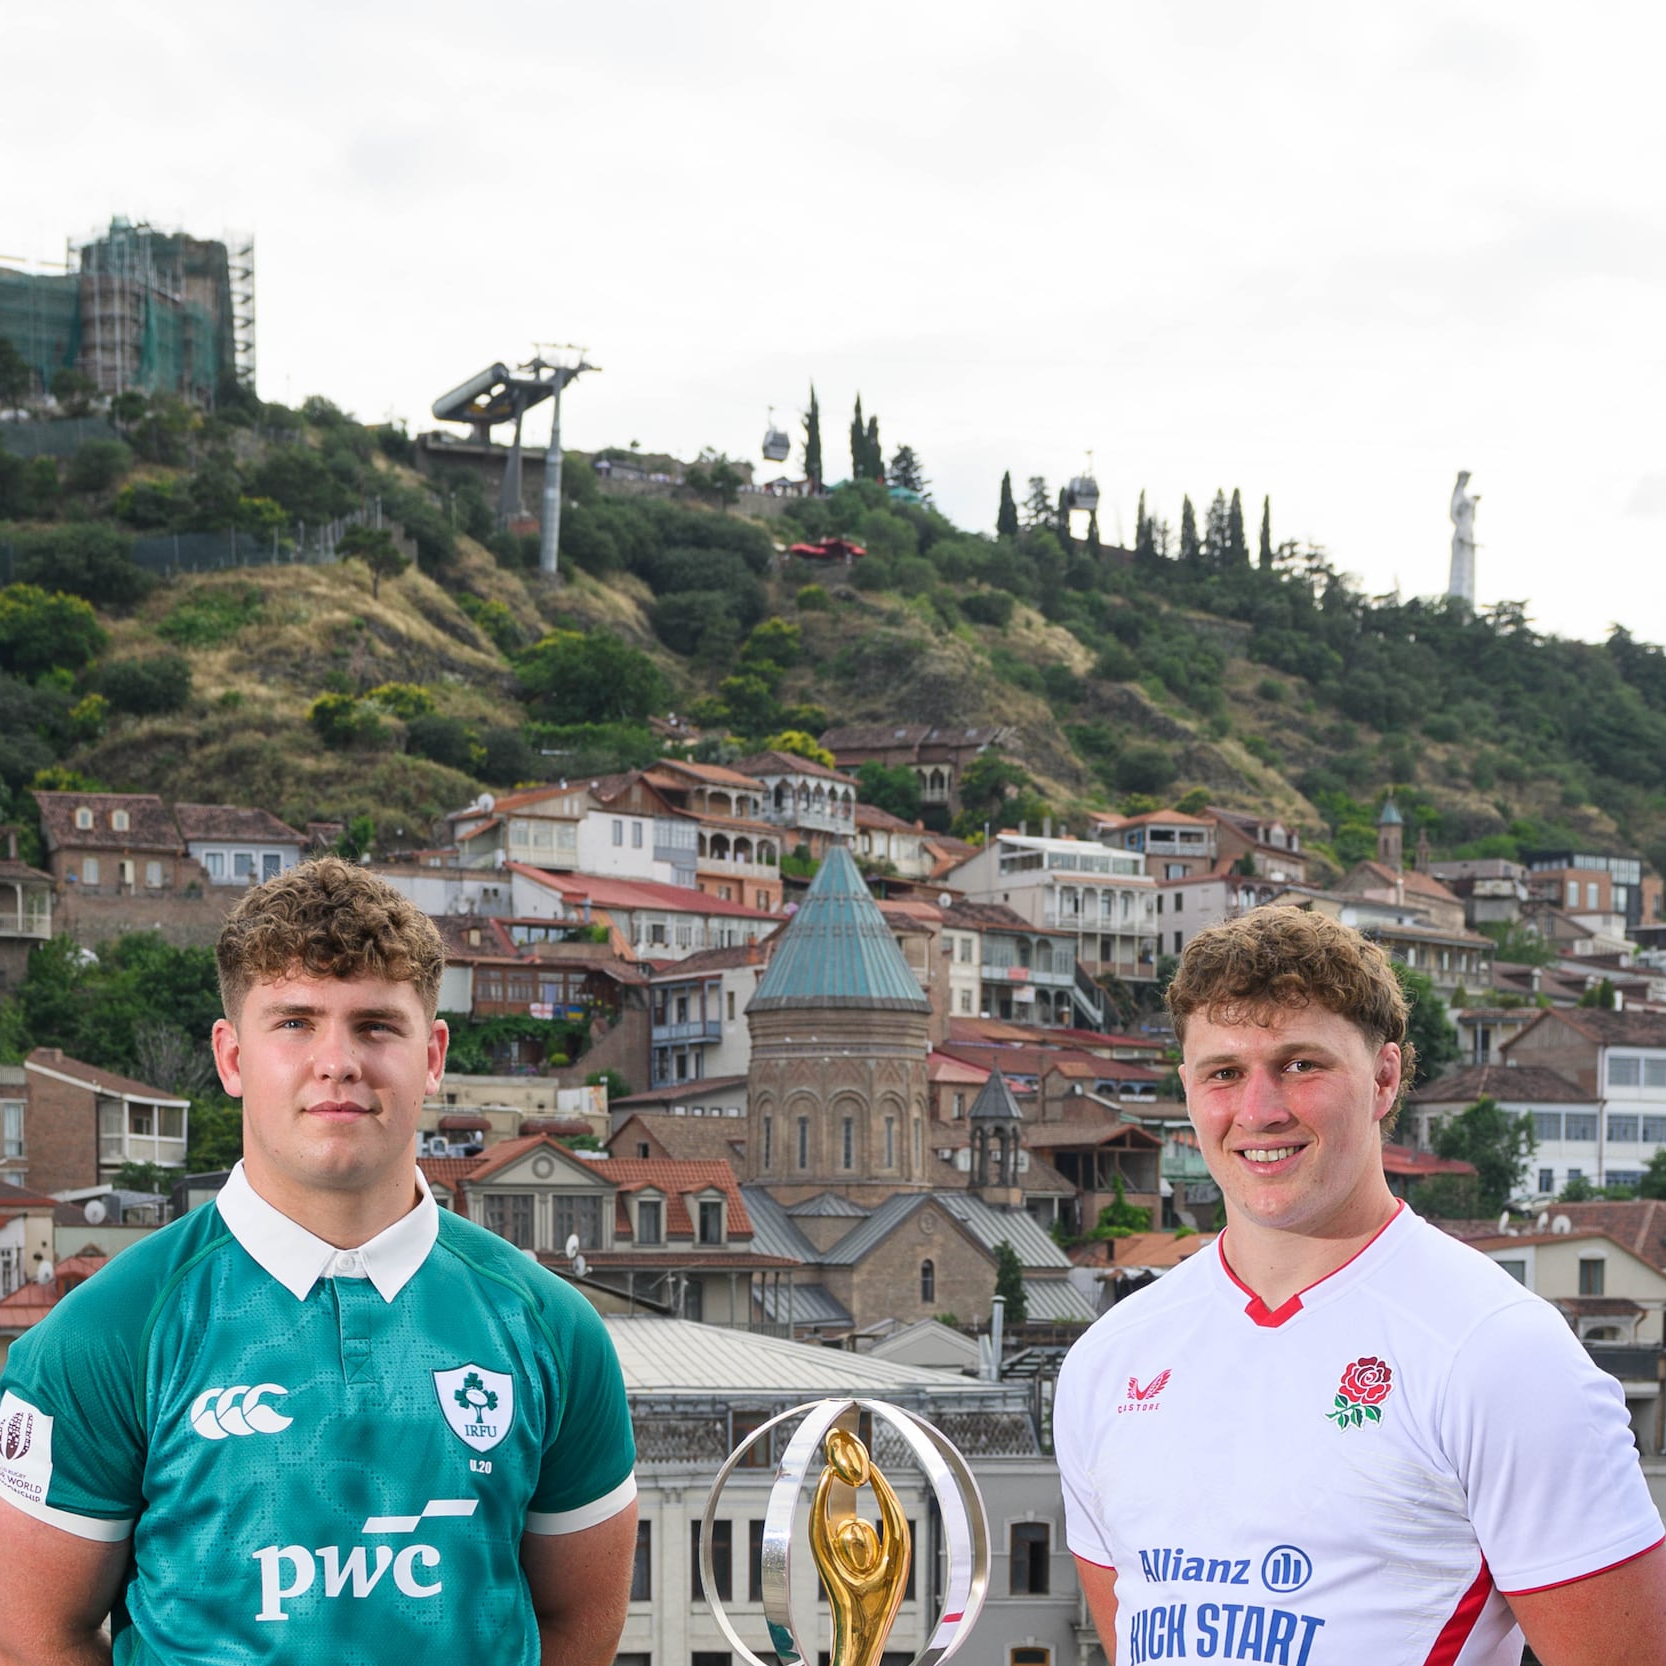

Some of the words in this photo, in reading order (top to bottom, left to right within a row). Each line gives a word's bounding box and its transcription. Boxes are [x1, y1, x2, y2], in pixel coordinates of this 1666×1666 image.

[464, 1424, 497, 1438] IRFU
[469, 1459, 493, 1475] U.20
[7, 1474, 42, 1494] WORLD
[1138, 1548, 1251, 1585] Allianz
[252, 1544, 443, 1622] pwc
